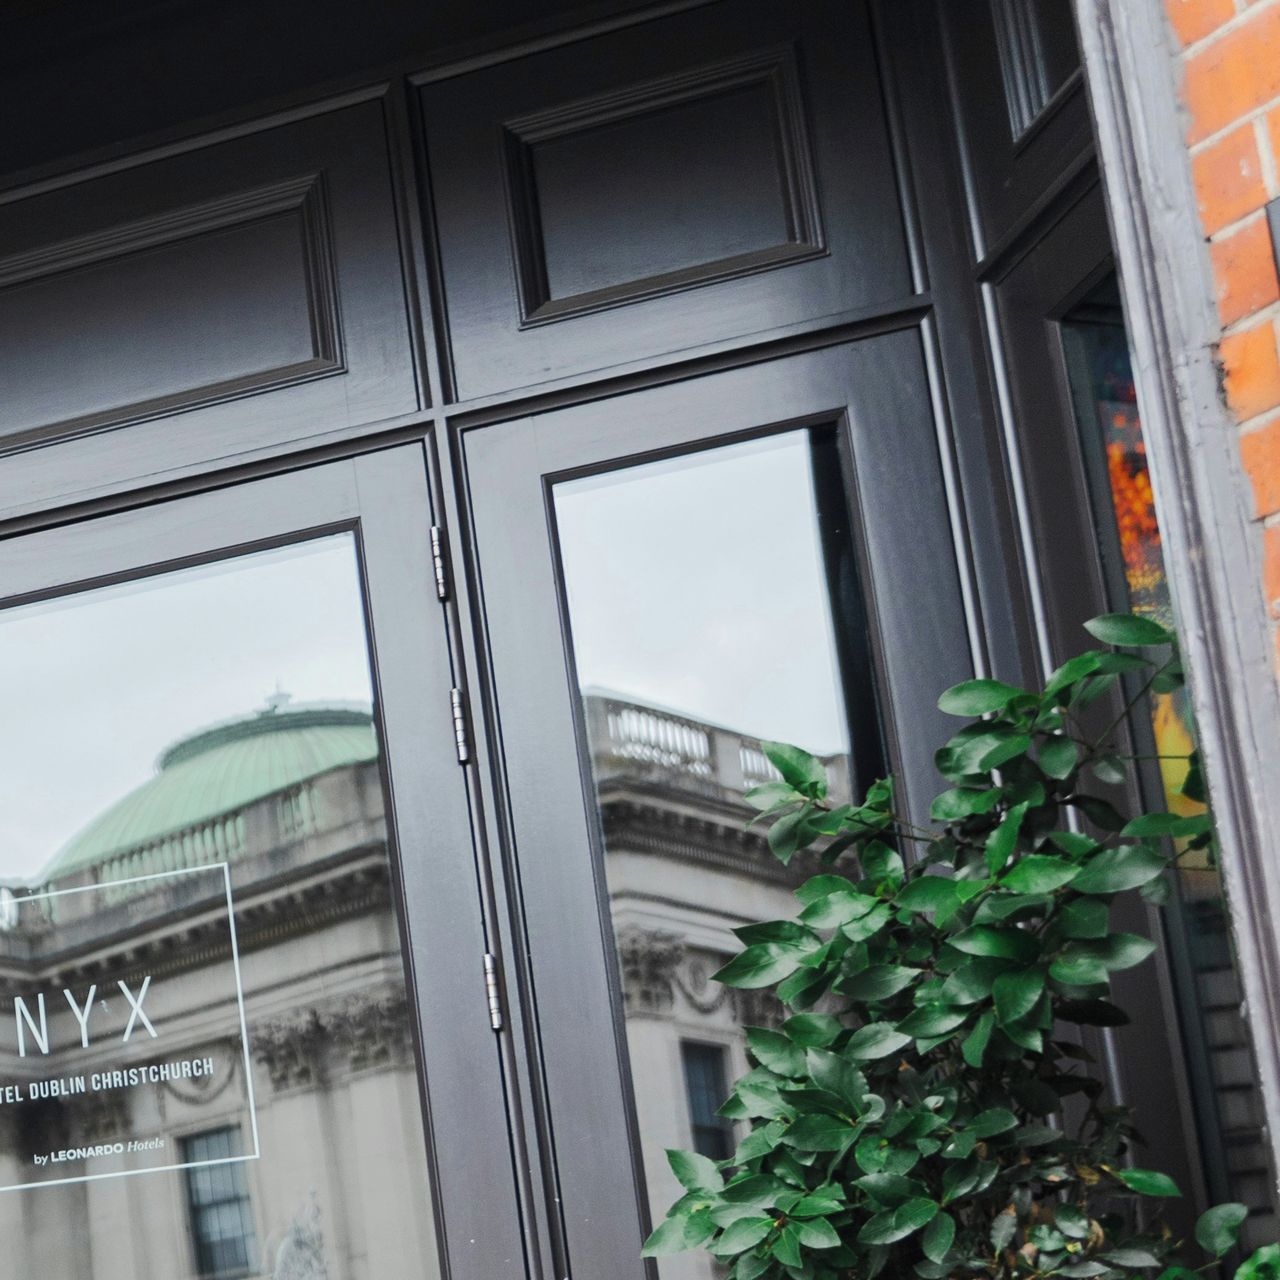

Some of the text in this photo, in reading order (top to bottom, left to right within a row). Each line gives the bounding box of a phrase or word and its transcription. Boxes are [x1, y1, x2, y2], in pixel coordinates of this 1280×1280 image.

[13, 975, 158, 1058] NYX
[28, 1075, 86, 1100] DUBLIN
[91, 1056, 214, 1092] CHRISTCHURCH
[33, 1137, 165, 1166] by LEONARDO Hotels
